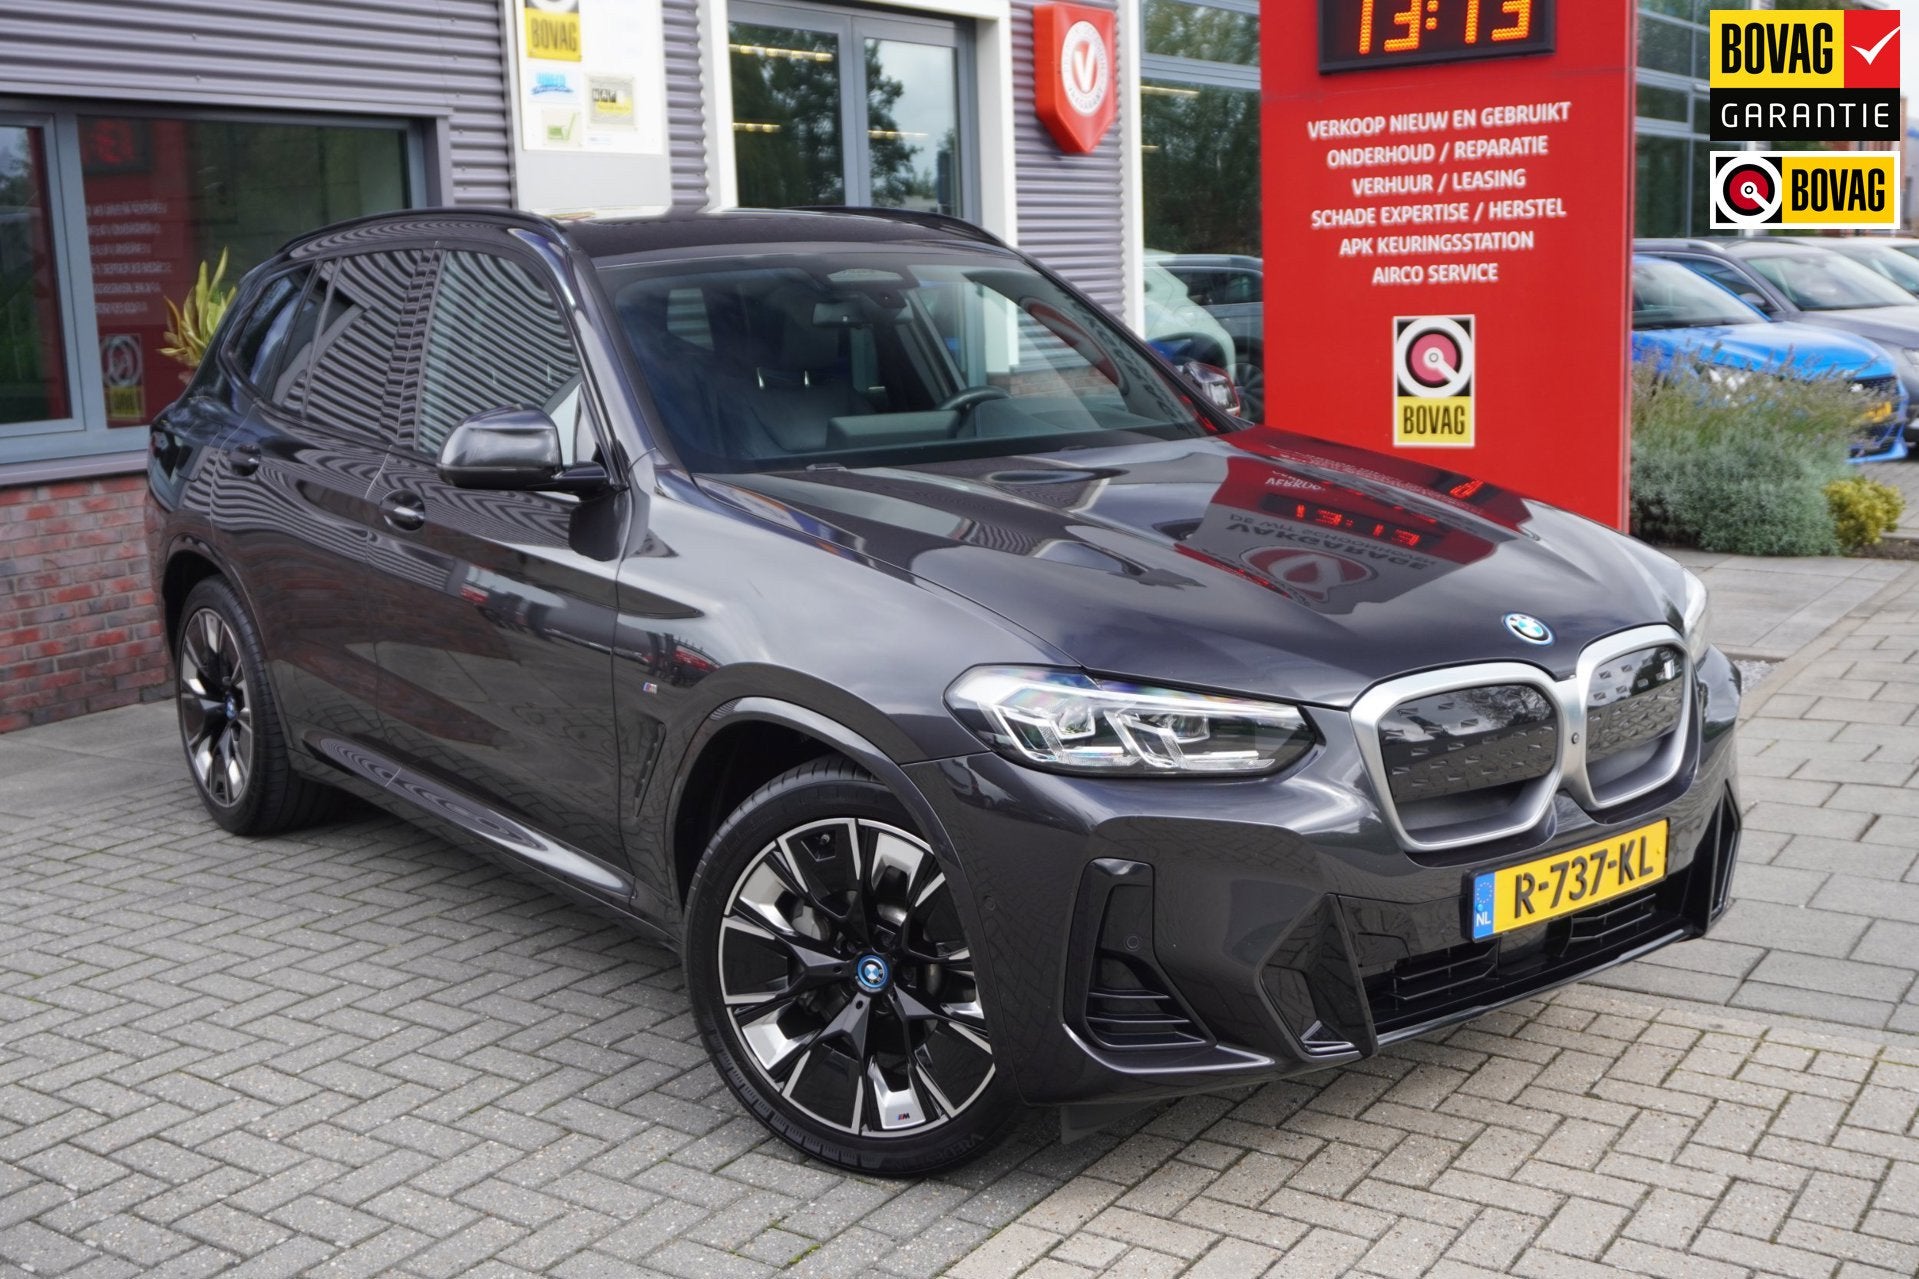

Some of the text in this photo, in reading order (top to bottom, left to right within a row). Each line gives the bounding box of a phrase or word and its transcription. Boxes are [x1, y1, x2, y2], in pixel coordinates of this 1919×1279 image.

[531, 18, 577, 52] BOVAG
[1359, 0, 1532, 54] 13:13
[1307, 101, 1571, 139] VERKOOP NIEUW EN GEBRUIKT
[1327, 135, 1549, 168] ONDERHOUD / REPARATIE
[1352, 168, 1527, 197] VERHUUR / LEASING
[1311, 198, 1567, 229] SCHADE EXPERTISE / HERSTEL
[1339, 230, 1535, 256] APK KEURINGSSTATION
[1372, 262, 1499, 286] AIRCO SERVICE
[1403, 405, 1465, 436] BOVAG
[1514, 835, 1654, 919] R-737-KL
[1476, 911, 1491, 927] NL
